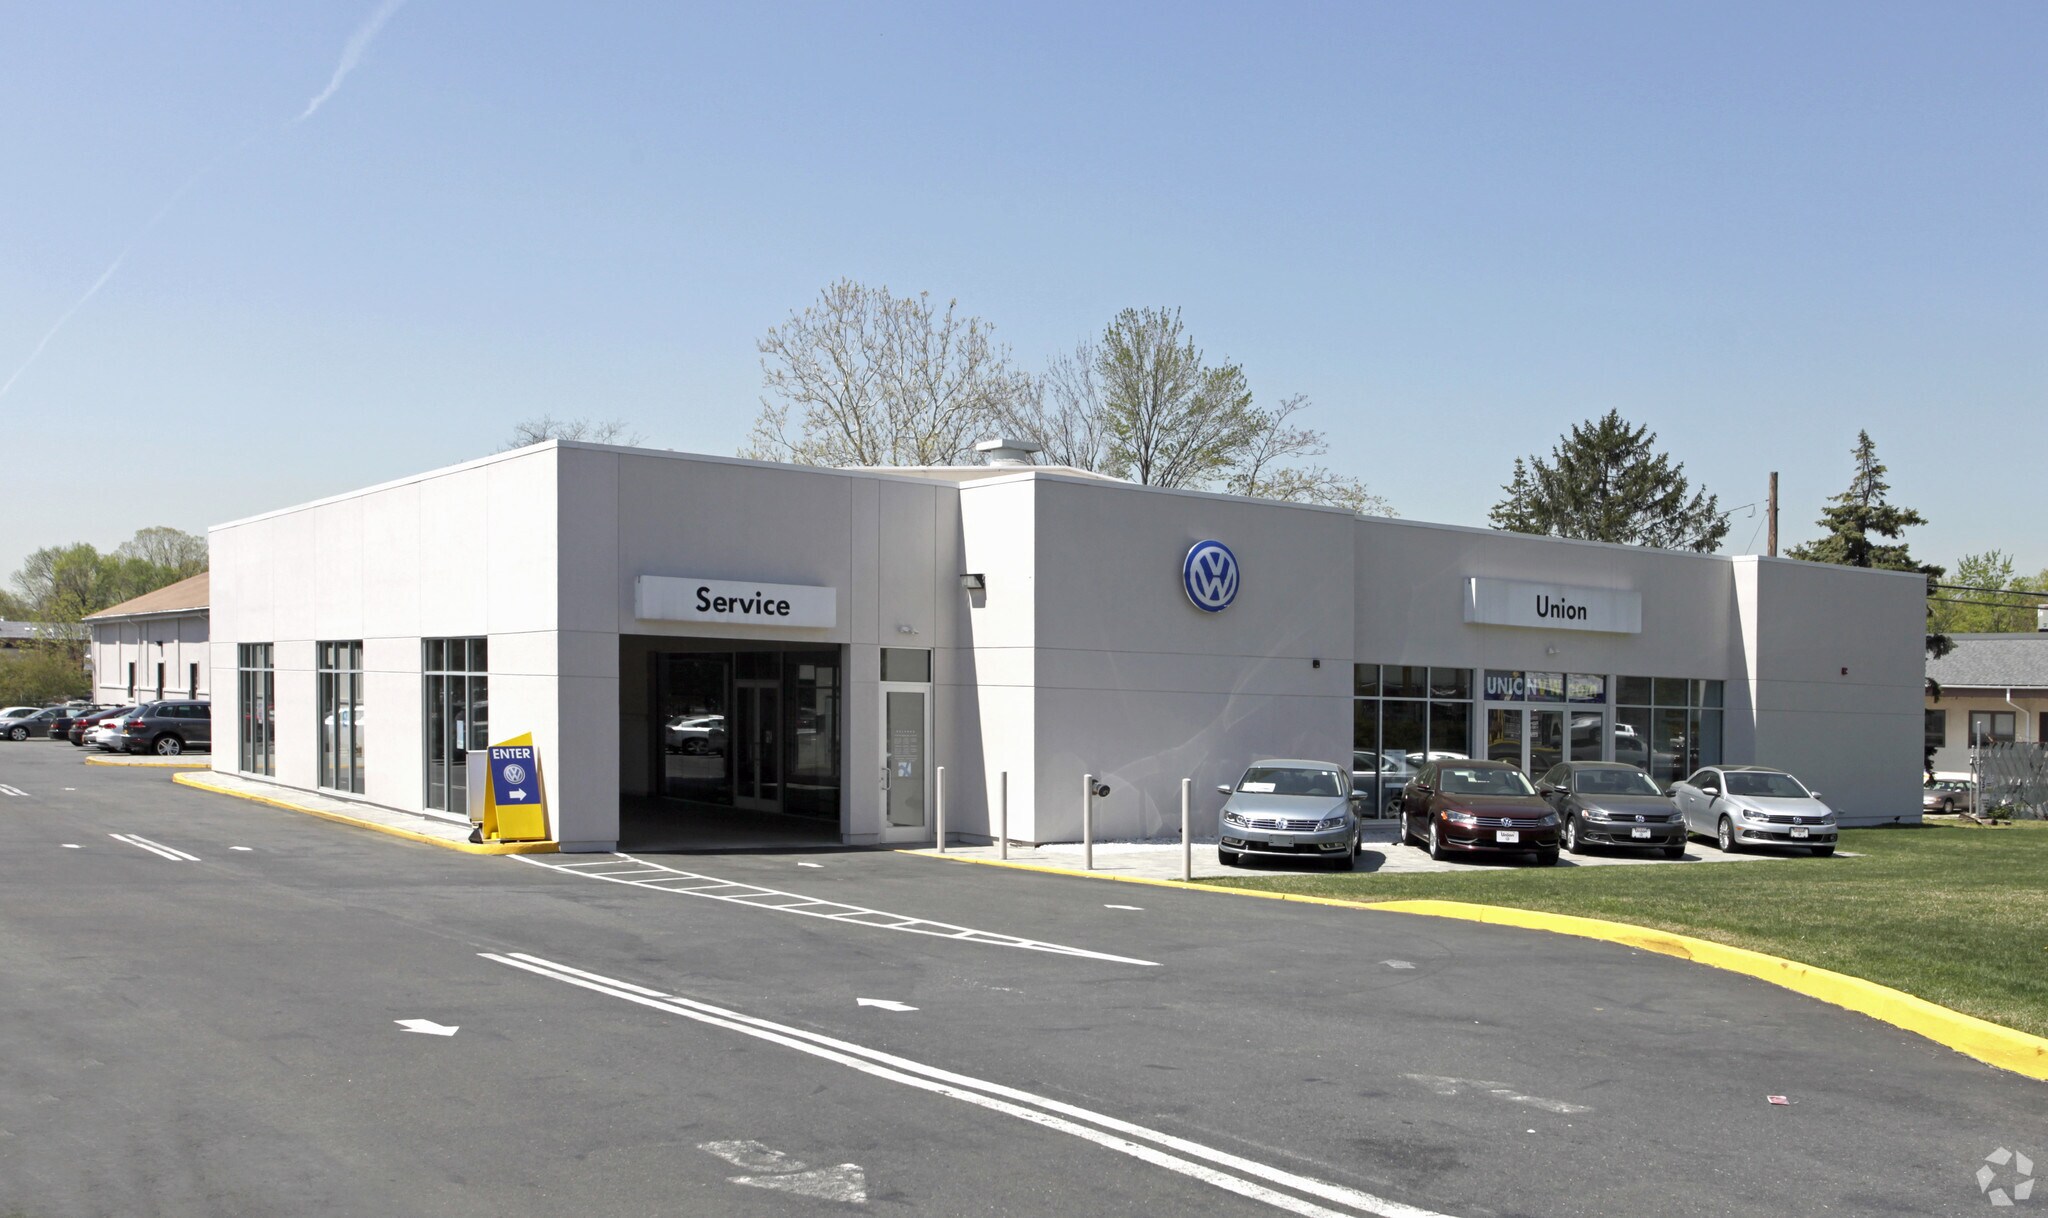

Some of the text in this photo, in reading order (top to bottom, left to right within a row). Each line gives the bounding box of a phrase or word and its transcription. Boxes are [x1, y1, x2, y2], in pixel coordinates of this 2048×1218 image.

[695, 586, 791, 616] Service
[1536, 595, 1587, 620] Union
[492, 748, 531, 760] ENTER
